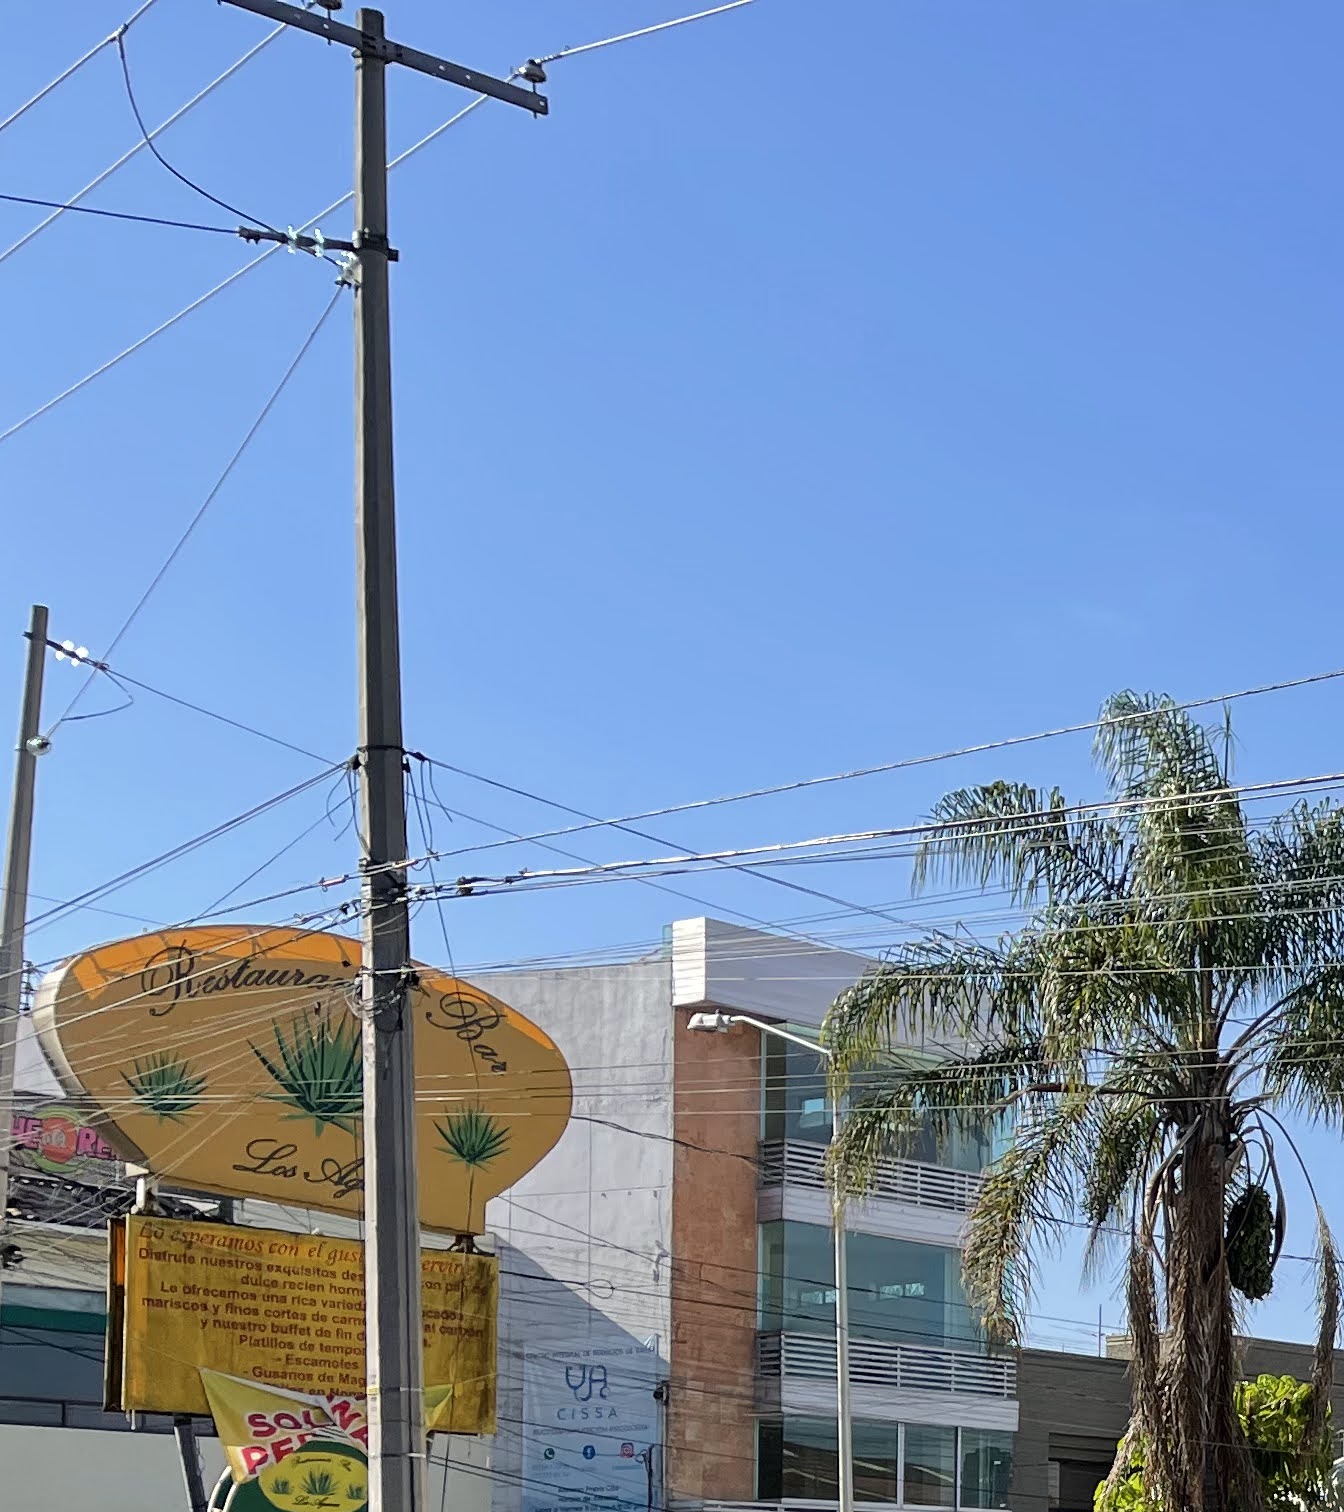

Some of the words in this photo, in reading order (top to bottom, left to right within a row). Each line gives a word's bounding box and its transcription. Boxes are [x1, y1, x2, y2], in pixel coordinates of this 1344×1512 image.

[426, 992, 507, 1076] Bar
[232, 1138, 298, 1178] Los
[303, 1157, 365, 1198] Ag
[268, 1243, 300, 1257] con
[308, 1241, 327, 1258] el
[326, 1247, 365, 1265] gus
[201, 1253, 262, 1272] nuestros
[267, 1263, 337, 1279] exquisitos
[341, 1267, 365, 1282] des
[240, 1273, 279, 1290] dulce
[283, 1280, 325, 1294] recien
[182, 1284, 257, 1302] ofrecemos
[262, 1293, 287, 1305] una
[291, 1293, 317, 1307] rica
[142, 1297, 208, 1313] mariscos
[212, 1304, 222, 1316] y
[225, 1303, 260, 1316] finos
[264, 1308, 308, 1322] cortes
[312, 1310, 329, 1323] de
[200, 1319, 208, 1331] y
[213, 1318, 267, 1334] nuestro
[271, 1321, 311, 1338] buffet
[315, 1326, 332, 1340] de
[336, 1328, 353, 1341] fin
[239, 1334, 295, 1351] Platillos
[299, 1338, 316, 1352] de
[285, 1353, 360, 1371] Escamoles
[252, 1366, 314, 1383] Gusanos
[317, 1370, 335, 1384] de
[556, 1406, 618, 1421] CISSA
